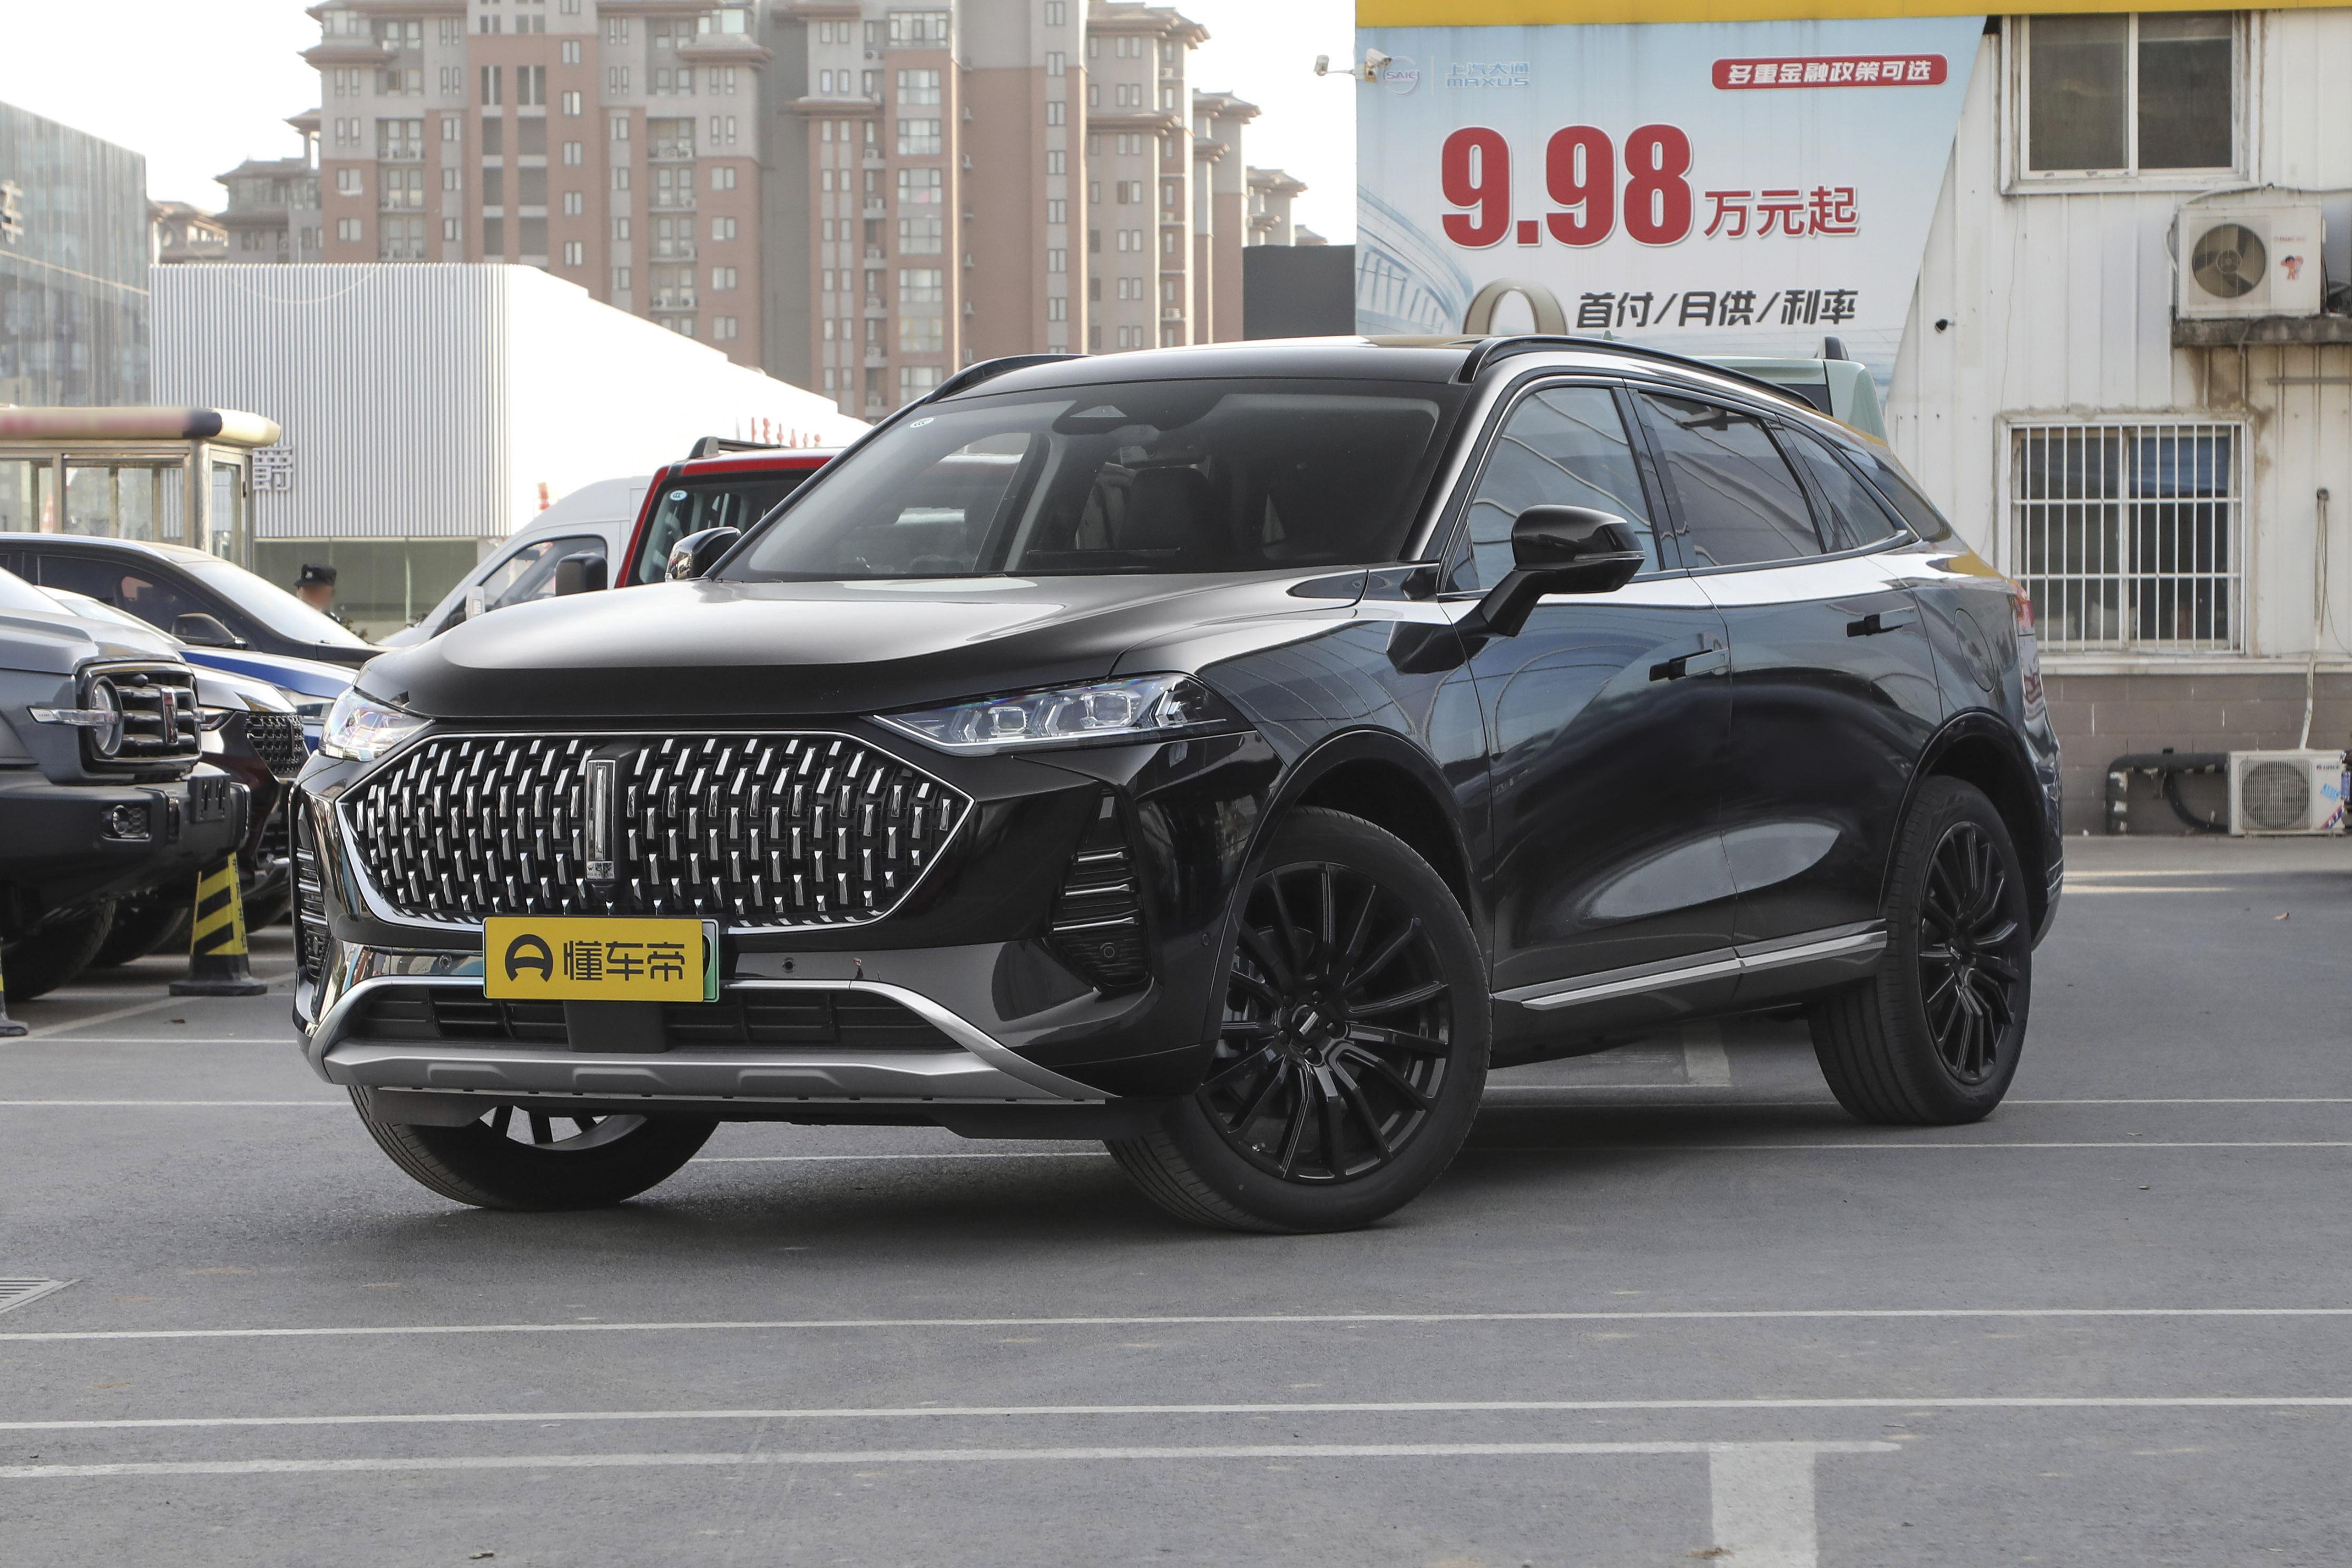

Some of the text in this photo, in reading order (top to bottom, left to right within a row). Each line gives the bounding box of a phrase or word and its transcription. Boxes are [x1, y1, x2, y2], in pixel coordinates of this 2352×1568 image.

[1386, 70, 1418, 80] SAIC
[1446, 62, 1530, 76] 上汽大通
[1727, 60, 1932, 85] 多重金融政策可选
[1446, 77, 1530, 87] MAXUS
[563, 940, 685, 982] 懂车帝
